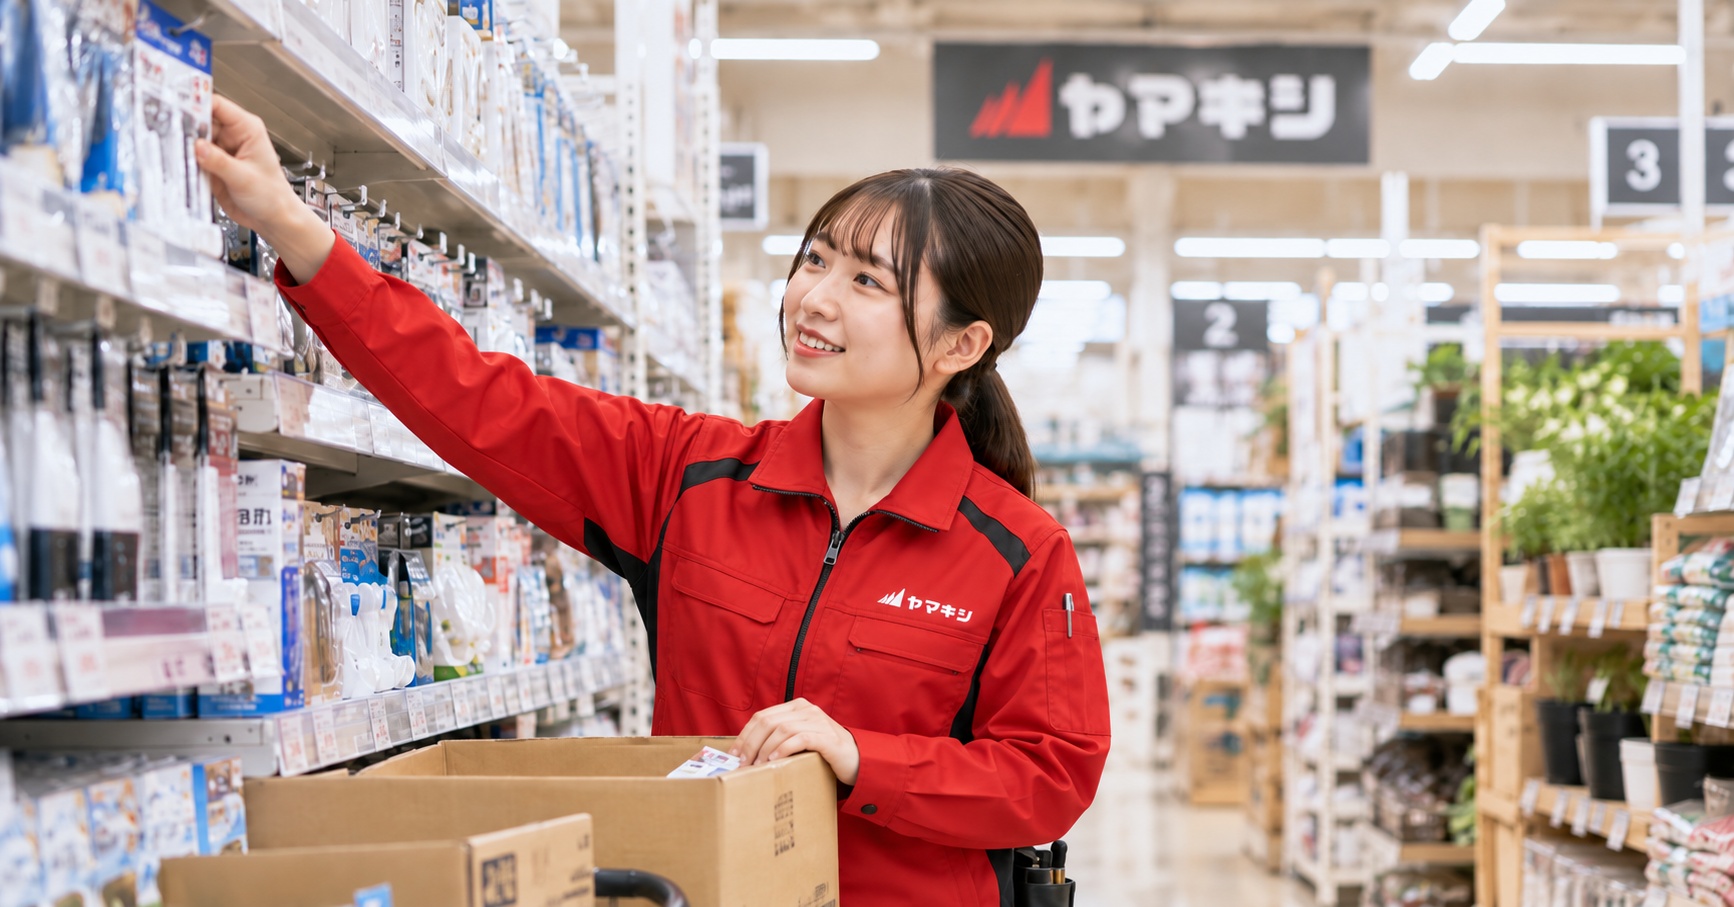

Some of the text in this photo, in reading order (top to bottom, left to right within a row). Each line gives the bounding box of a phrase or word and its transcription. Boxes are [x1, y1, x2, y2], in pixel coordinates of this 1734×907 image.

[1060, 74, 1335, 139] ヤマキシ
[1626, 139, 1661, 191] 3
[1203, 303, 1238, 347] 2
[907, 595, 973, 623] ヤマキシ
